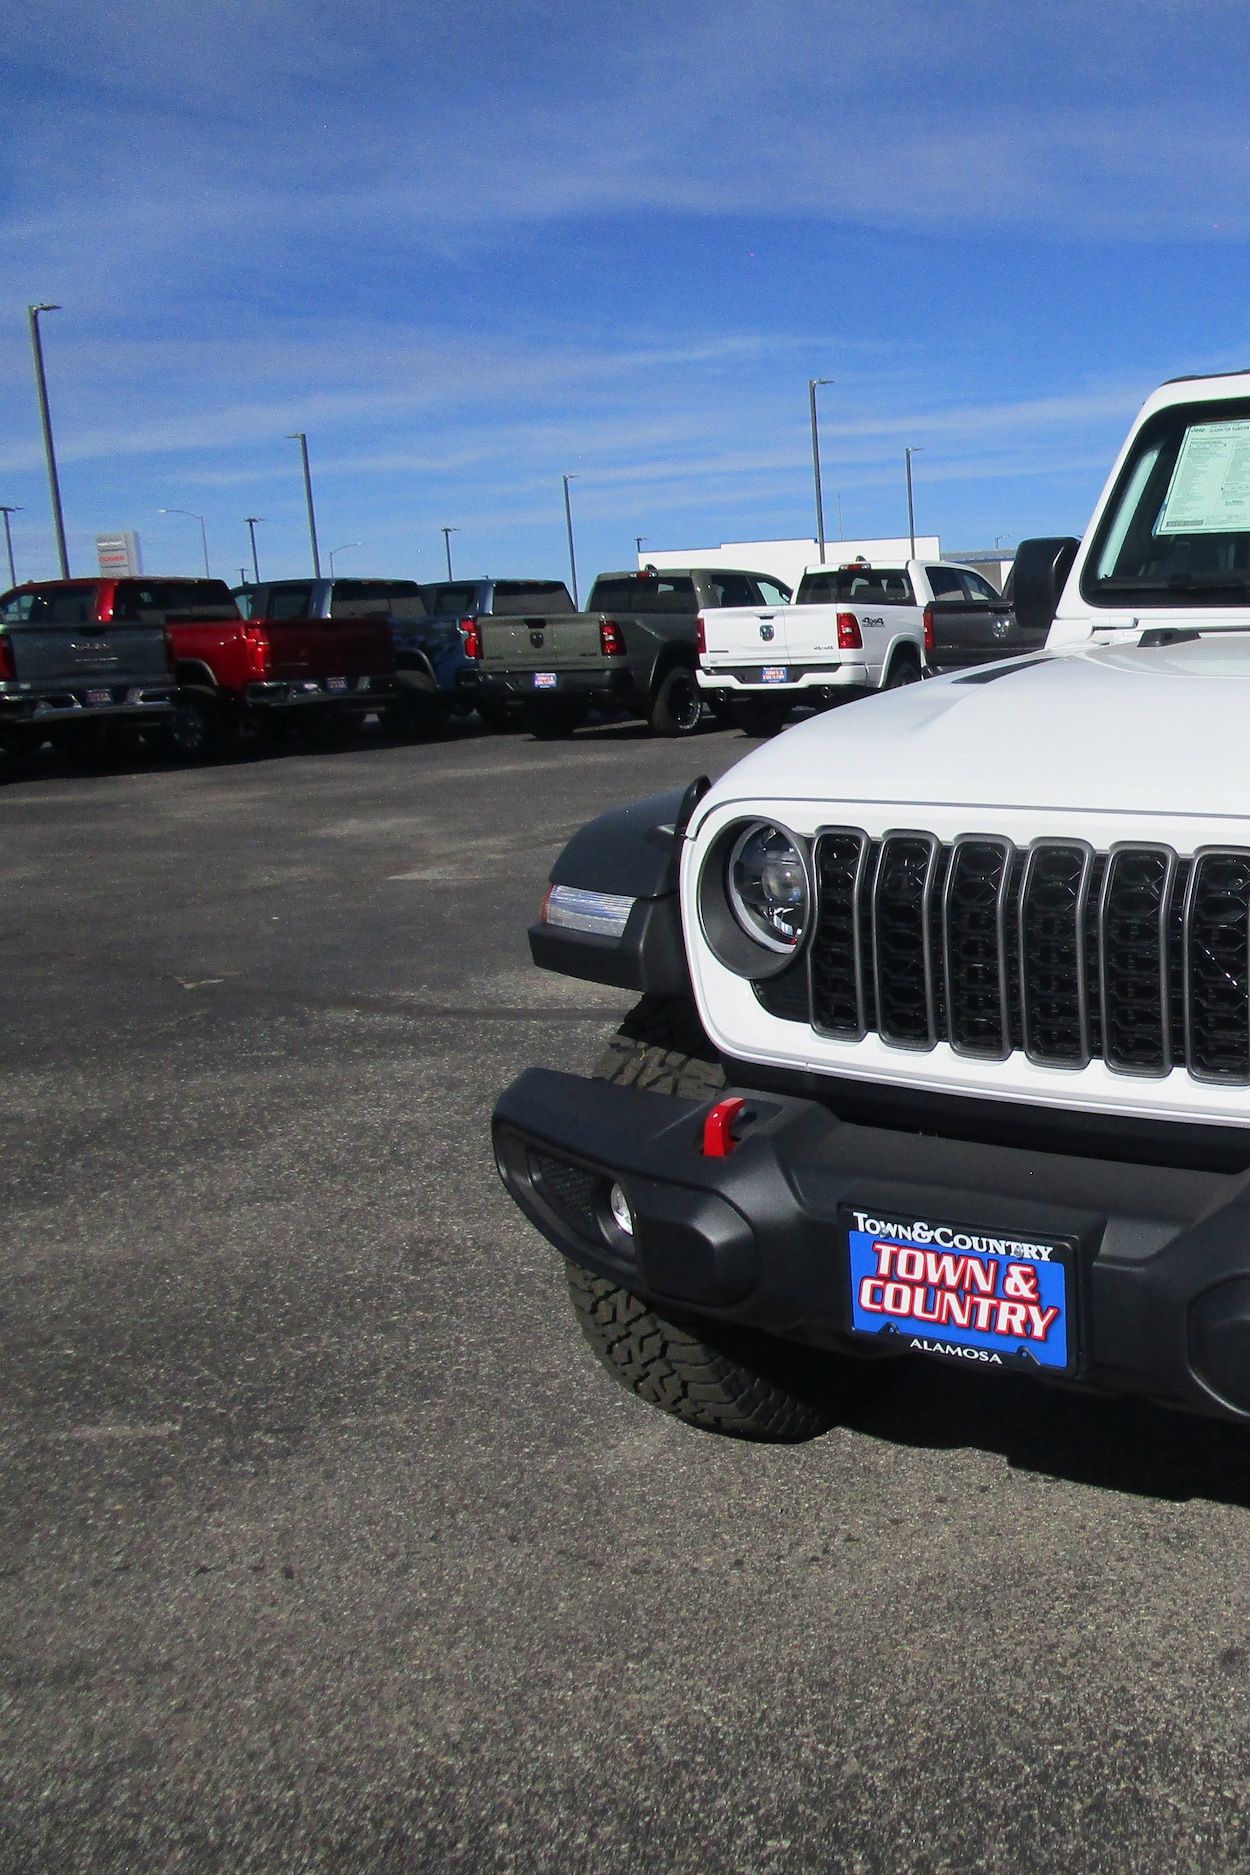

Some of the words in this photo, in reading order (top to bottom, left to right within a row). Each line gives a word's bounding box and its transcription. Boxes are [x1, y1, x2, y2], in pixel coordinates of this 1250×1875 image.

[873, 1241, 998, 1296] TOWN
[1003, 1262, 1040, 1302] &
[859, 1276, 1059, 1342] COUNTRY
[910, 1338, 1003, 1365] ALAMOSA
